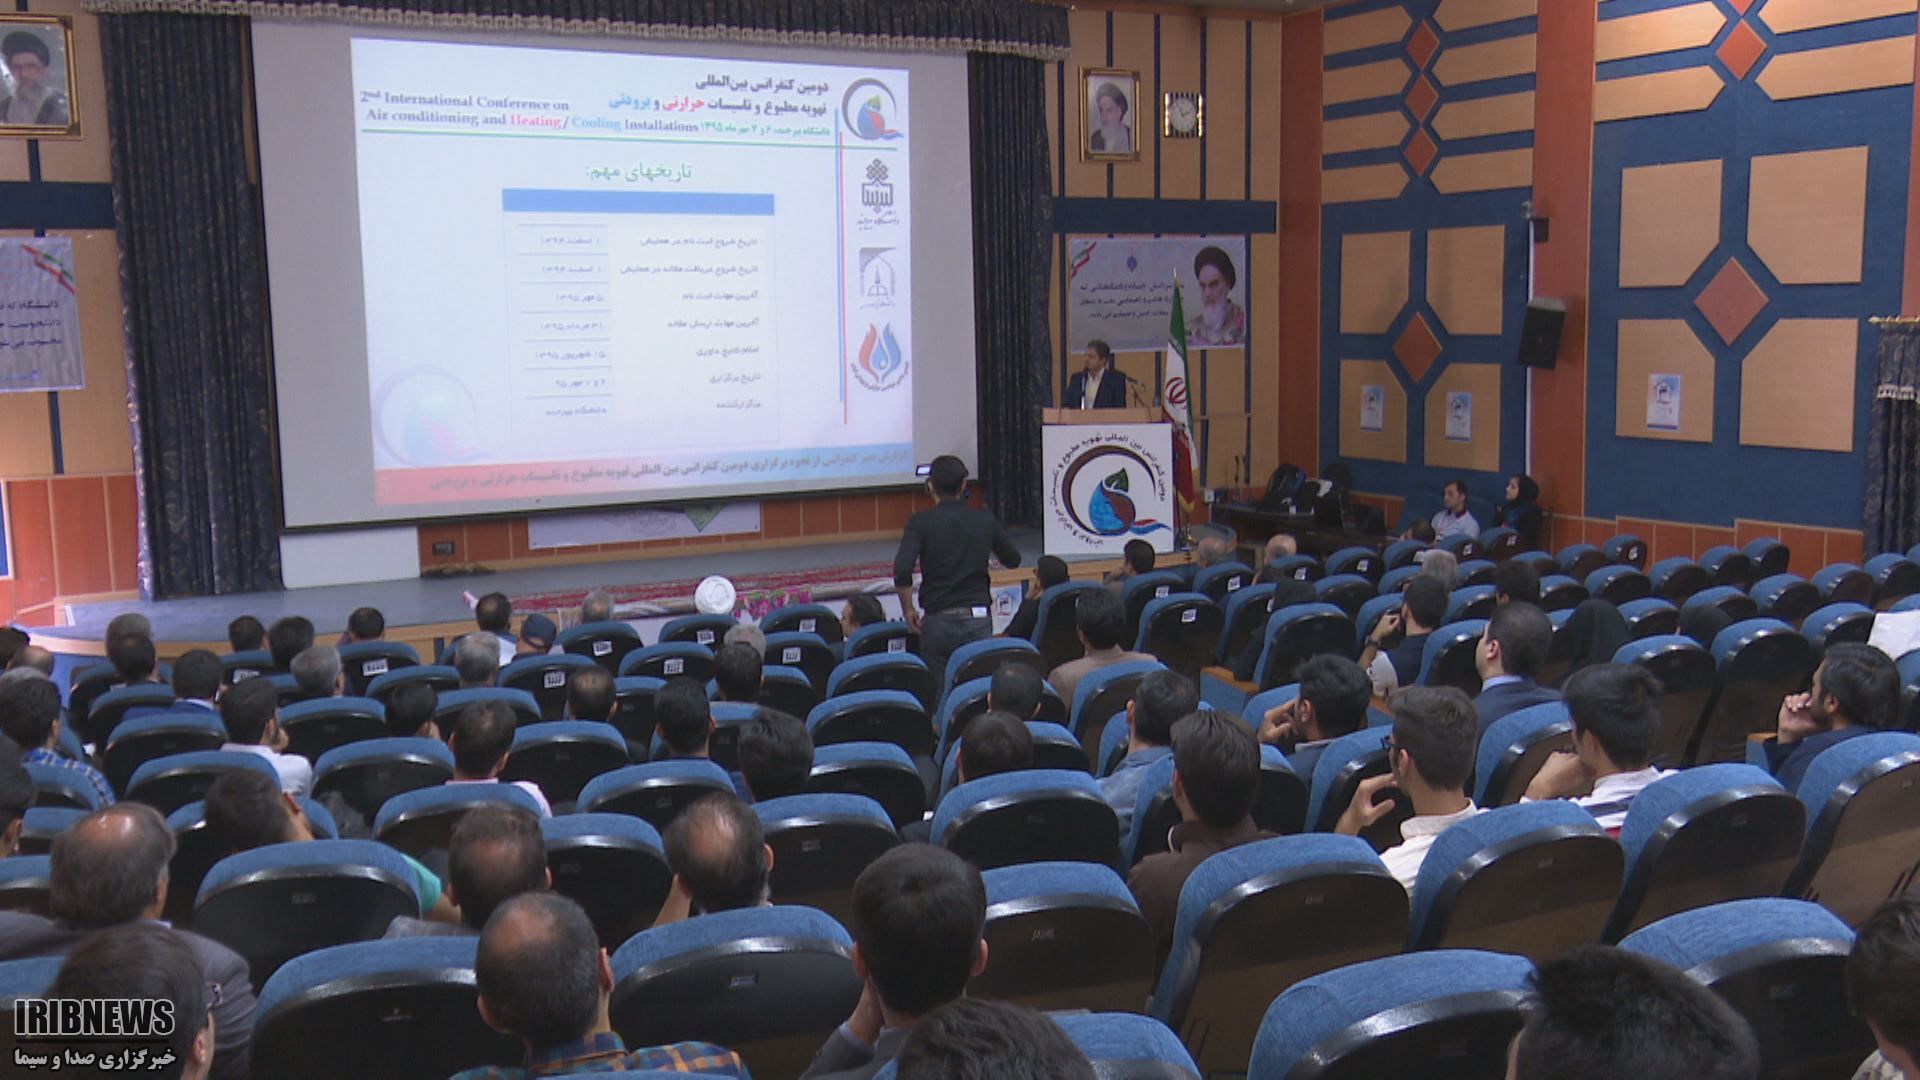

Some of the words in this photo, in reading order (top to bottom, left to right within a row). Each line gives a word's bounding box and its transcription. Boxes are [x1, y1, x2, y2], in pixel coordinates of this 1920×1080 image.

[750, 77, 795, 94] کنفرانس
[797, 81, 829, 96] دومین
[360, 91, 382, 104] 2nd
[384, 92, 474, 108] International
[476, 97, 551, 111] Conference
[553, 101, 569, 111] on
[609, 93, 651, 110] برودتی
[653, 99, 660, 112] و
[662, 96, 705, 112] حرارتی
[754, 103, 761, 115] و
[764, 100, 799, 116] مطبوع
[801, 103, 827, 118] تهویه
[366, 109, 388, 122] Air
[391, 109, 480, 127] conditioning
[482, 114, 507, 126] and
[571, 116, 622, 132] Cooling
[624, 118, 698, 133] Installations
[1105, 432, 1129, 442] المللی
